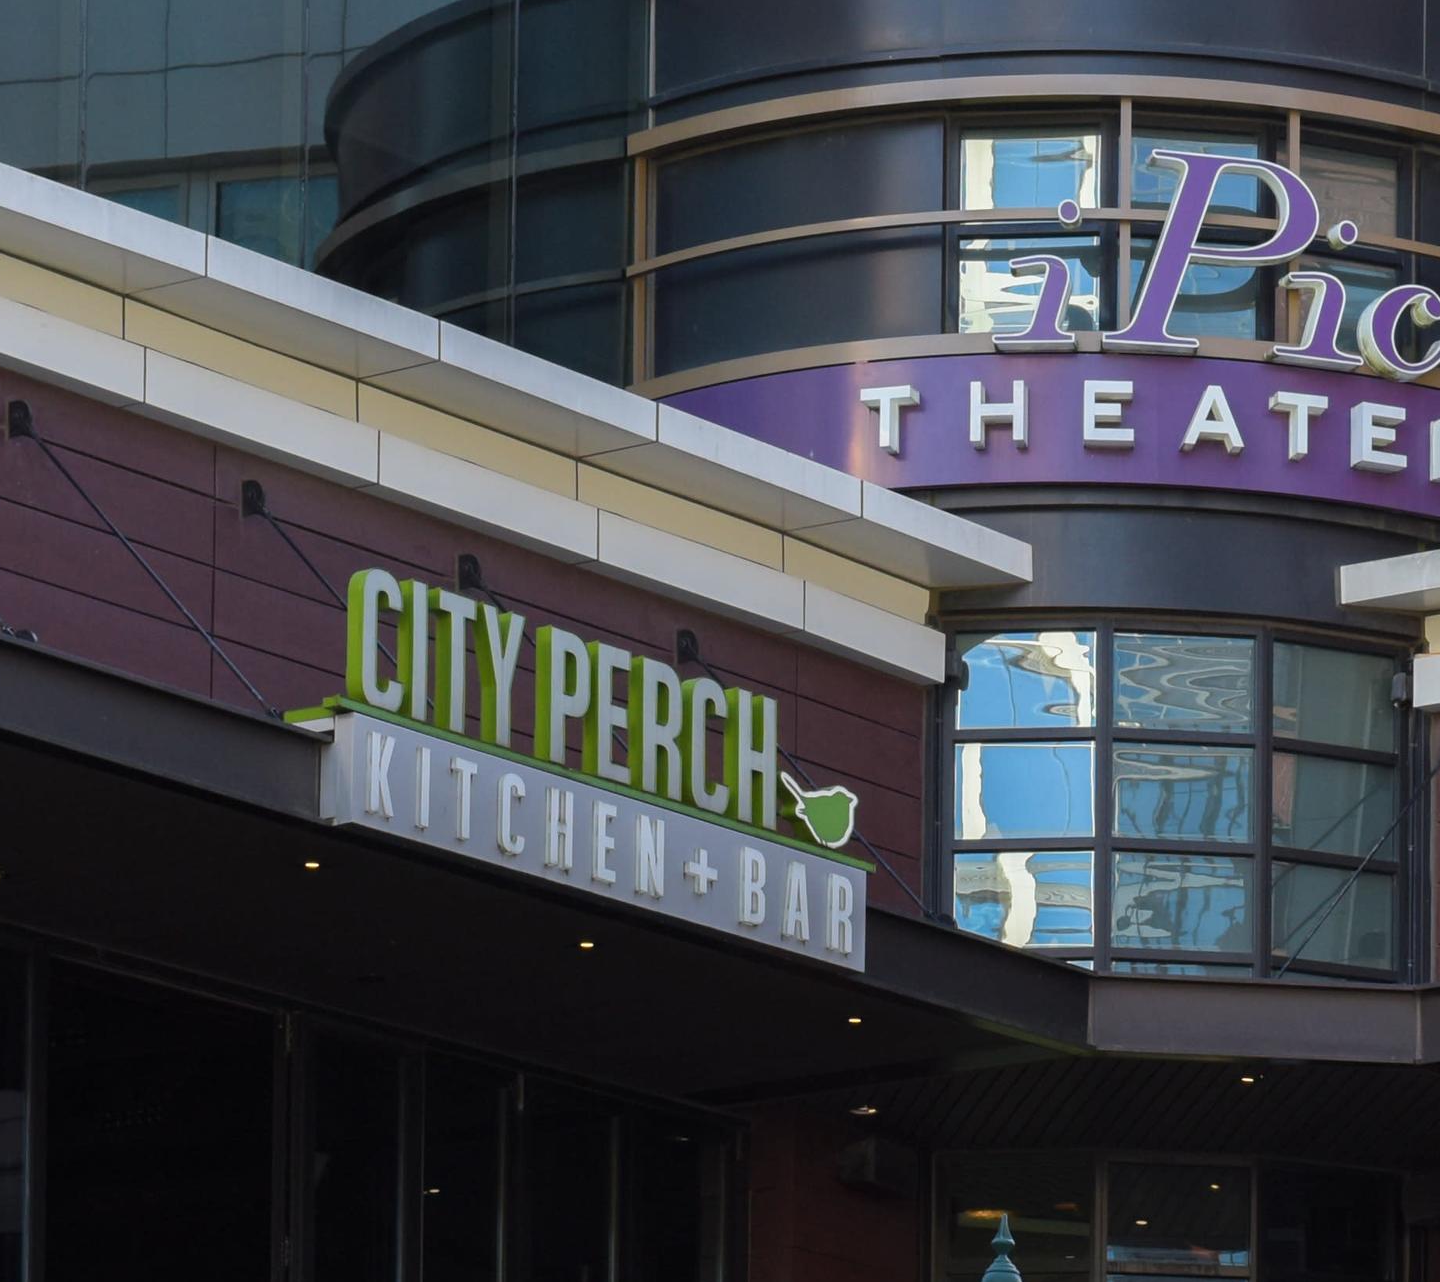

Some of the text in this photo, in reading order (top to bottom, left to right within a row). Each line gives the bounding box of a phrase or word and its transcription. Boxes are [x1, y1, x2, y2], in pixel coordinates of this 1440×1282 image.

[346, 568, 778, 832] CITY PERCH
[365, 730, 665, 898] KITCHEN
[739, 846, 854, 955] BAR
